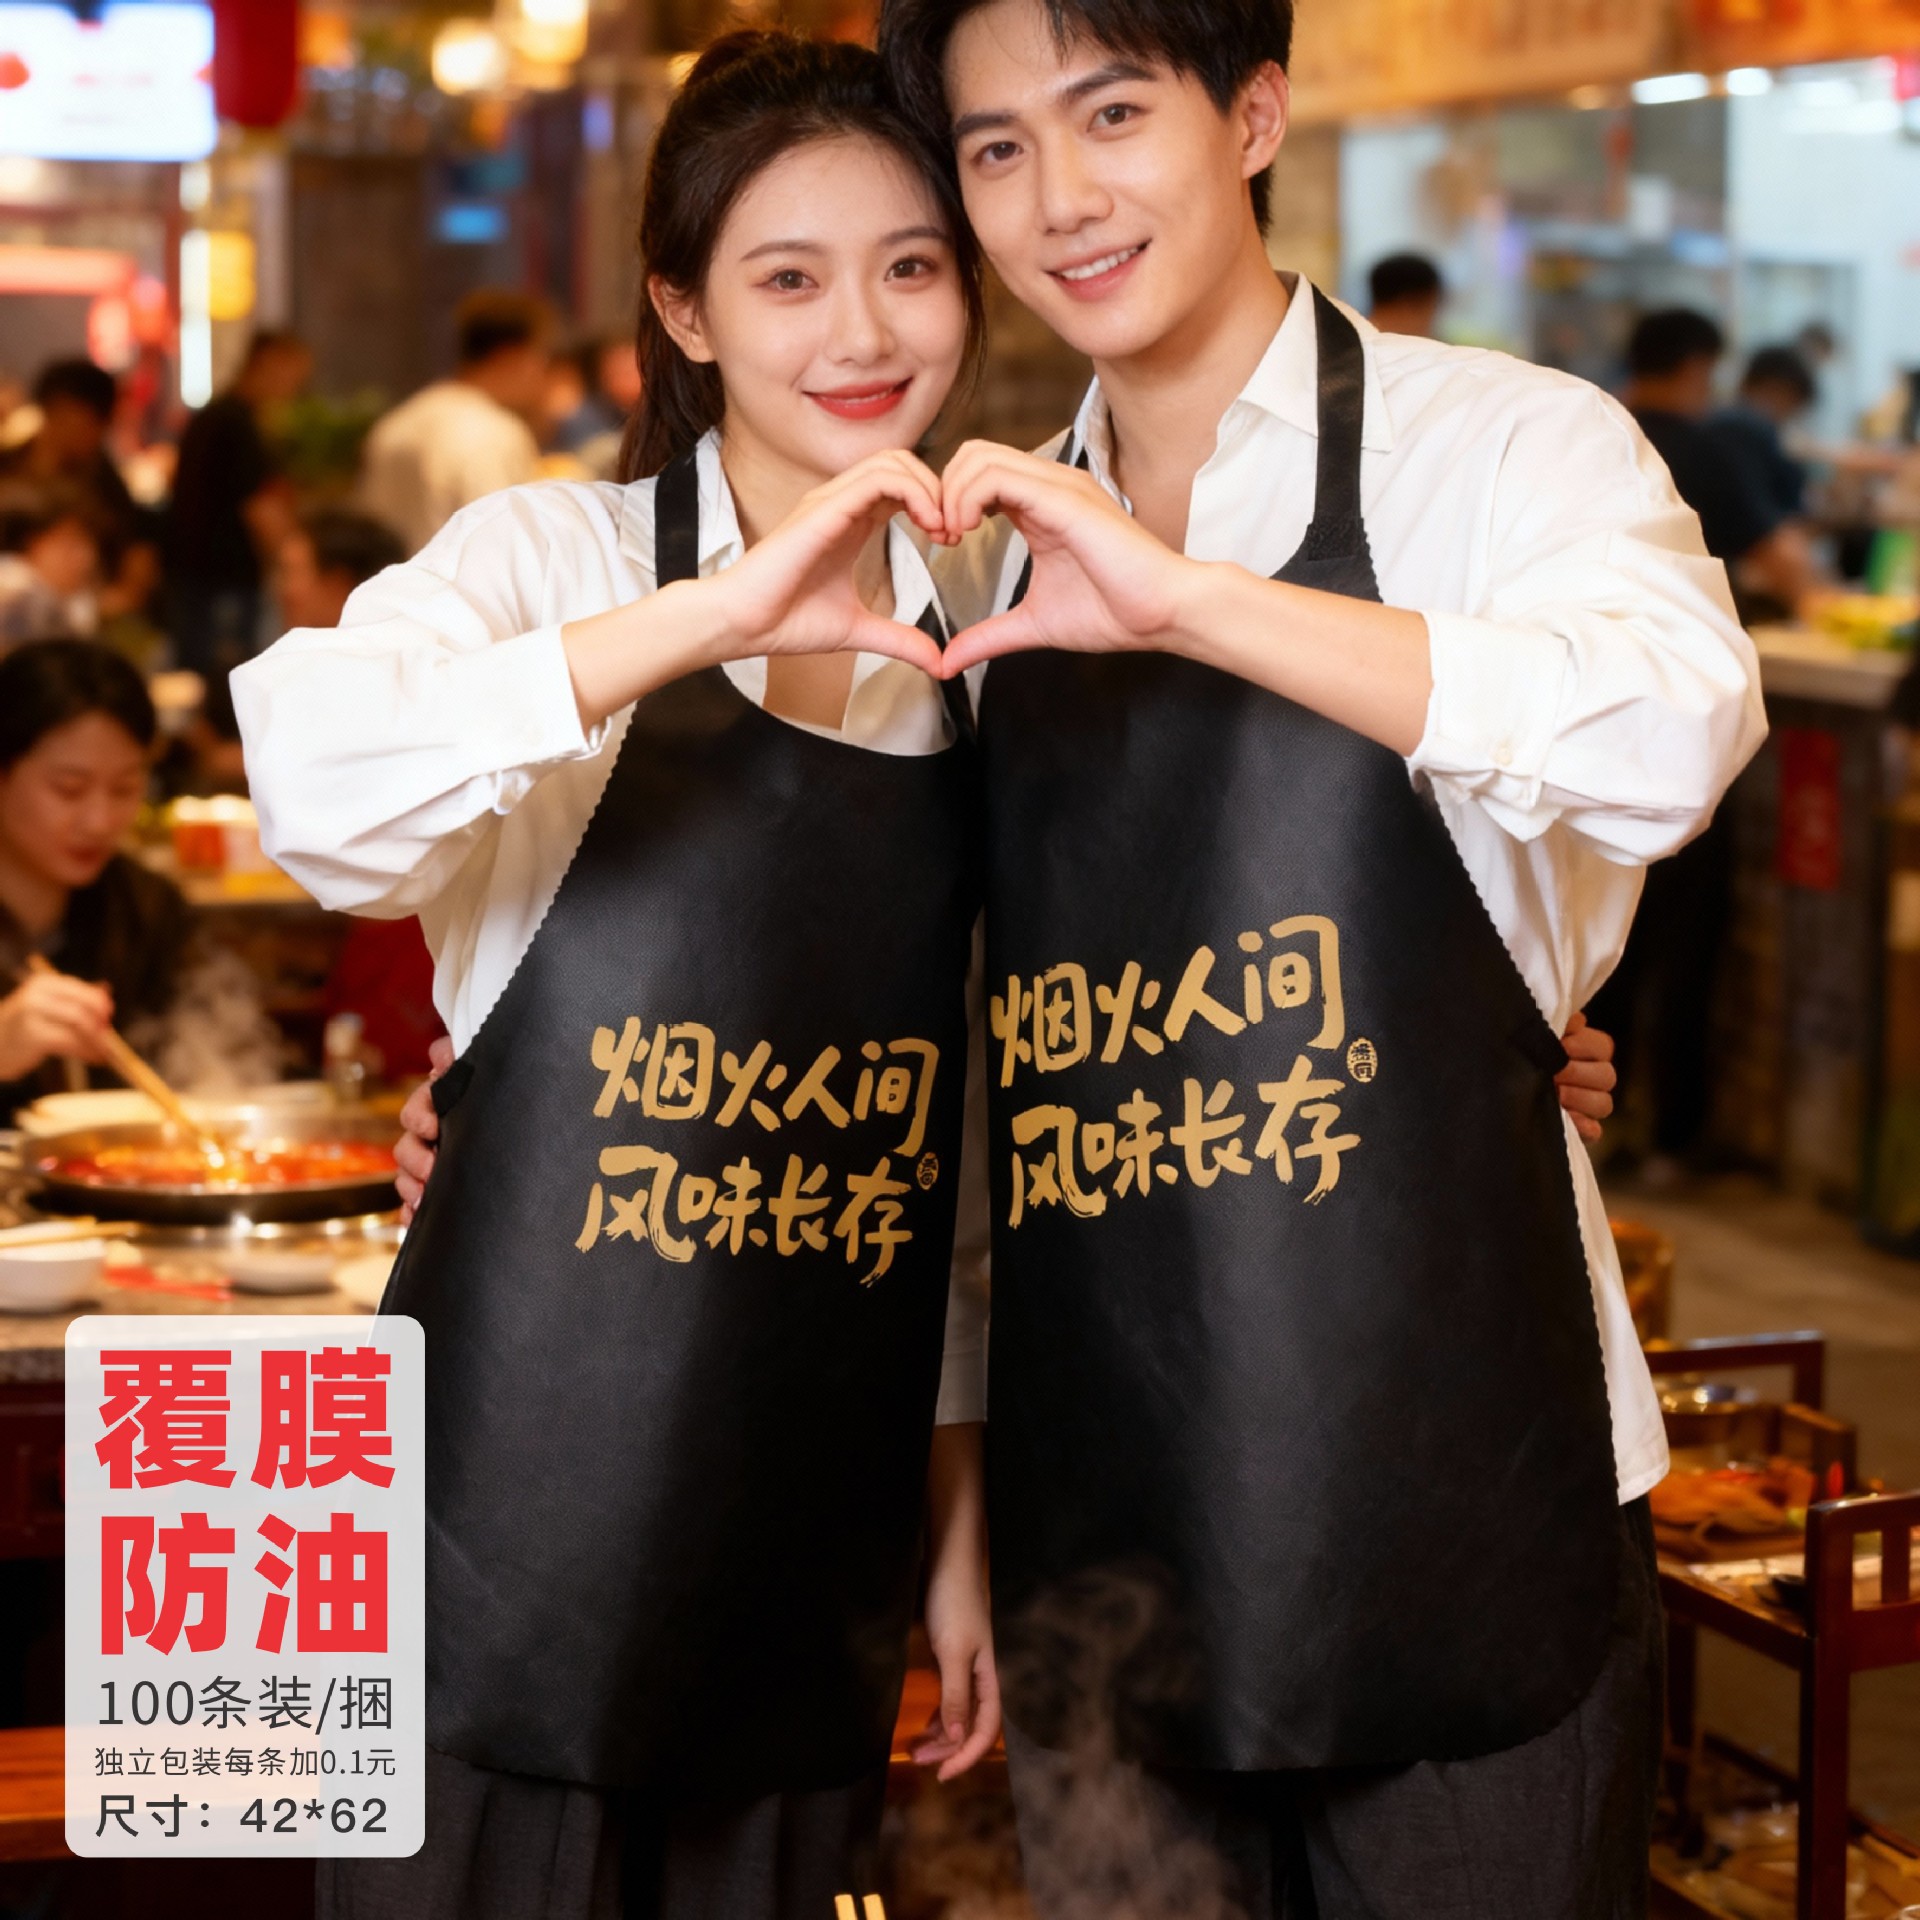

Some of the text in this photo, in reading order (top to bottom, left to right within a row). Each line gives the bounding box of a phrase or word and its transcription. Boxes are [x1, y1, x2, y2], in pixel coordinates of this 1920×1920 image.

[990, 915, 1346, 1088] 烟火人间
[590, 1016, 940, 1157] 烟火人间
[1008, 1055, 1362, 1229] 风味长存
[575, 1145, 913, 1288] 风味长存
